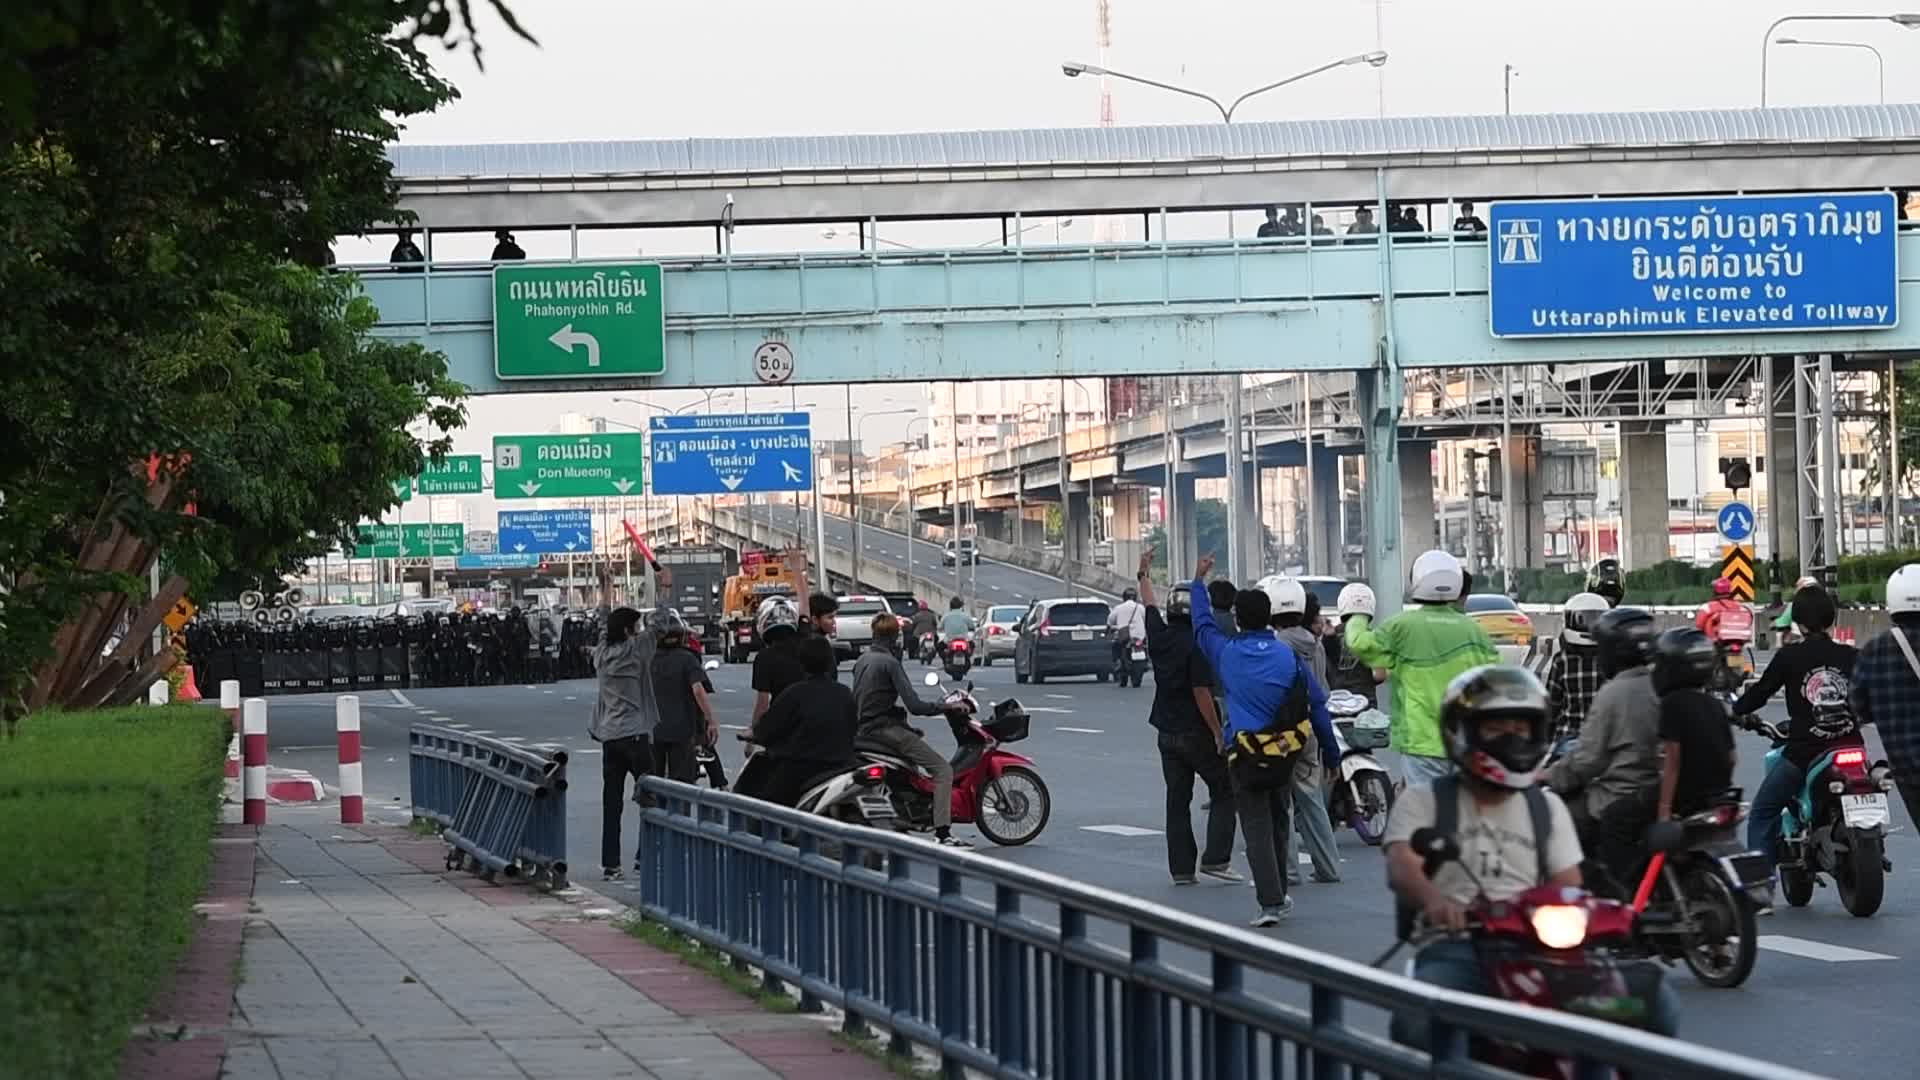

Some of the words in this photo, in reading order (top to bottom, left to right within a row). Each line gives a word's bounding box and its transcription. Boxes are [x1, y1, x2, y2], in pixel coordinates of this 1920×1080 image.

[1557, 203, 1883, 245] ทางยกระดับอุตราภิมุข
[1632, 244, 1803, 280] ยินดีต้อนรับ
[509, 270, 647, 300] ถนนพหลโยธิน
[1652, 284, 1751, 301] Welcome
[1764, 282, 1787, 299] to
[525, 302, 609, 319] Phahonyothin
[616, 301, 635, 315] Rd.
[1532, 306, 1686, 327] Uttaraphimuk
[1696, 304, 1794, 324] Elevated
[1804, 302, 1889, 323] Tollway
[760, 355, 780, 370] 5.0
[537, 438, 612, 460] ดอนเมือง
[679, 435, 736, 452] ดอนเมือง
[501, 456, 514, 467] 31
[538, 468, 562, 478] Don
[565, 467, 611, 479] Mueang
